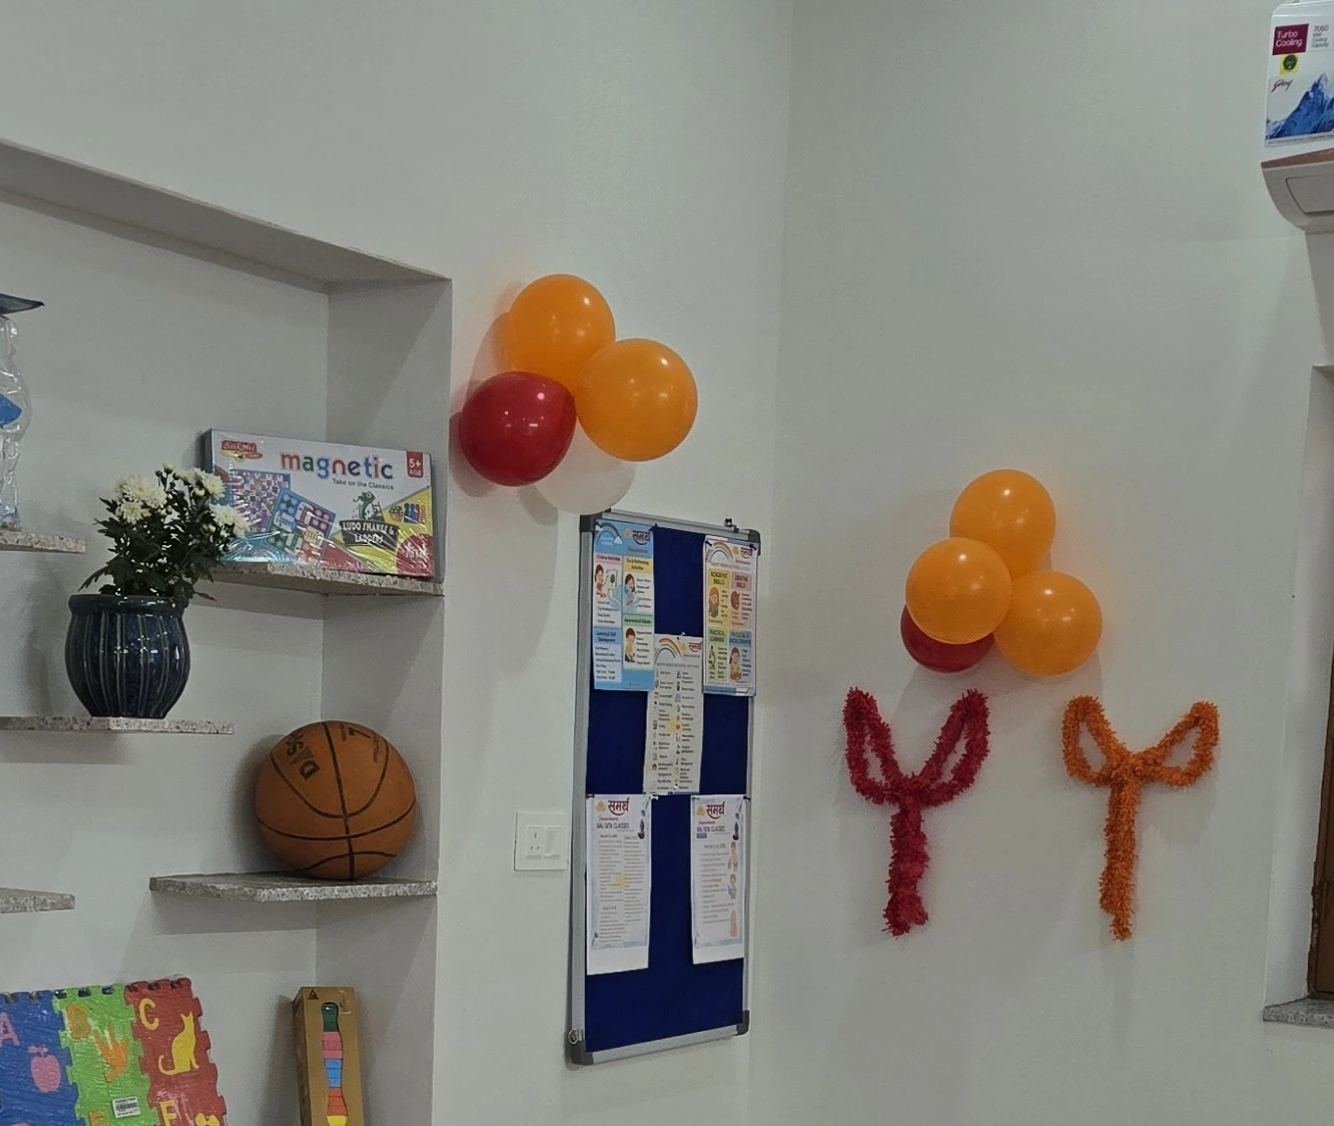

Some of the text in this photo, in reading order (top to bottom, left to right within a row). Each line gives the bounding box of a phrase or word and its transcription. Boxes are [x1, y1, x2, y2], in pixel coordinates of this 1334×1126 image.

[1277, 30, 1299, 39] Turbo
[1276, 38, 1303, 48] Cooling
[280, 451, 394, 480] magnetic
[409, 458, 422, 469] 5+
[332, 478, 347, 487] Take
[357, 480, 367, 488] the
[368, 482, 394, 490] Classics
[342, 522, 361, 531] LUDO
[608, 797, 630, 816] समर्थ
[139, 998, 160, 1031] C
[66, 1004, 90, 1039] B
